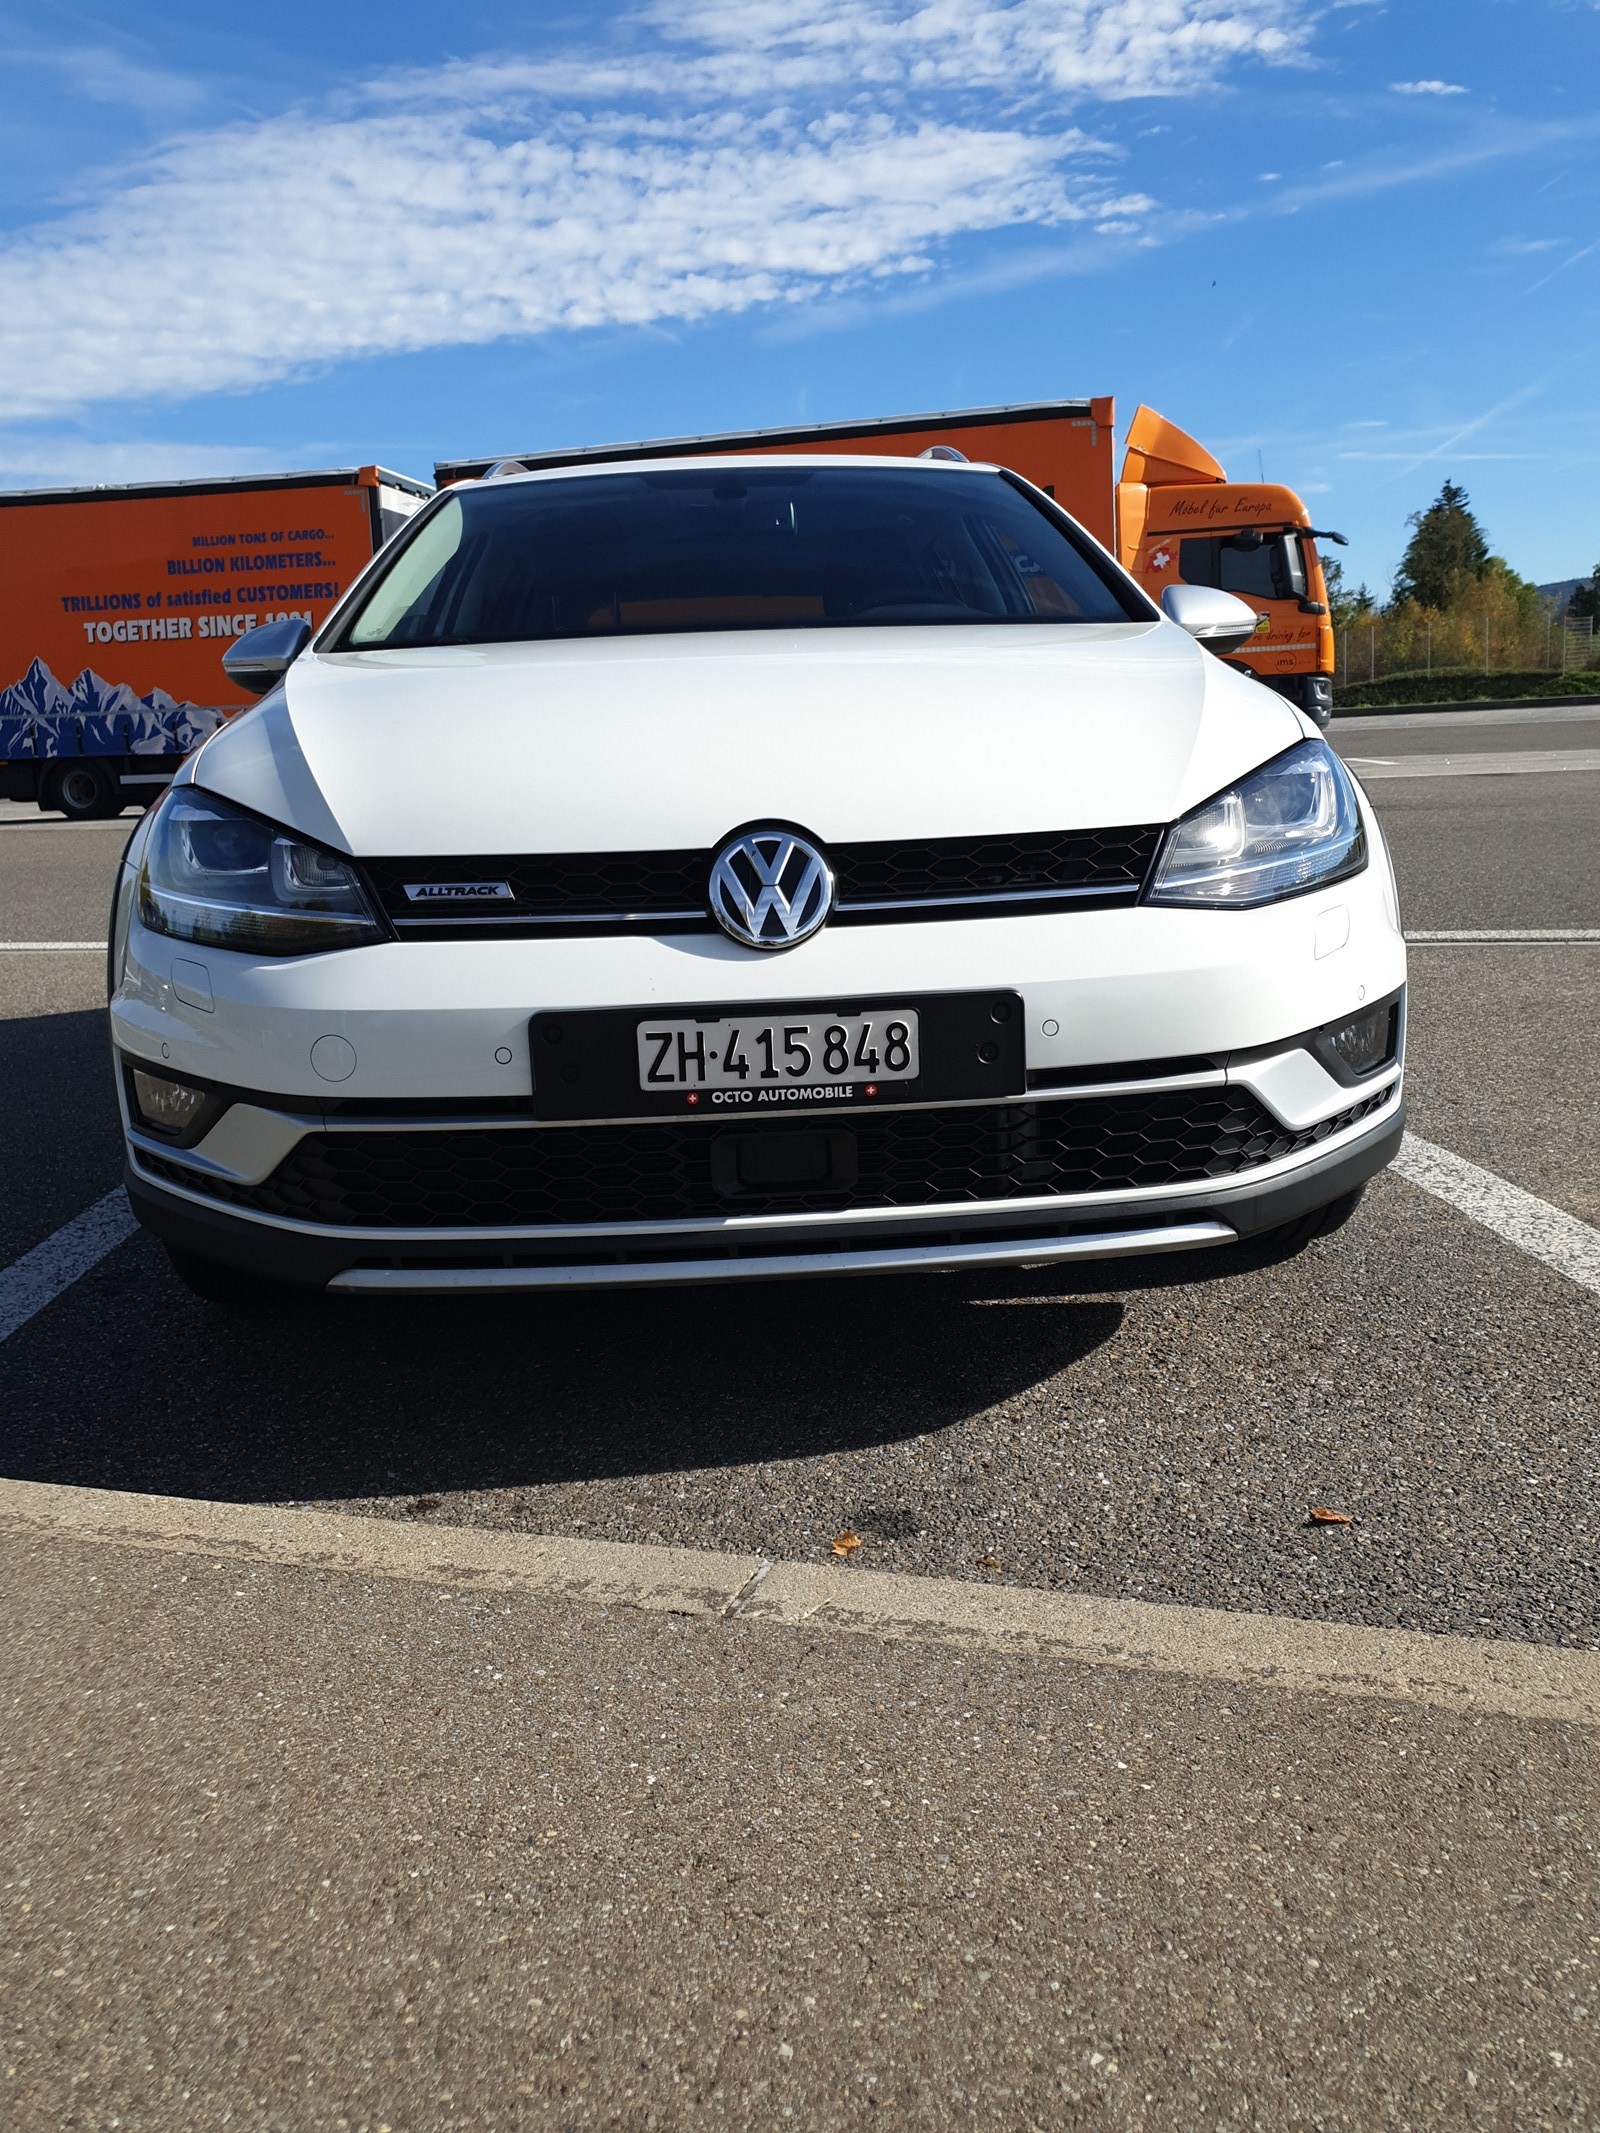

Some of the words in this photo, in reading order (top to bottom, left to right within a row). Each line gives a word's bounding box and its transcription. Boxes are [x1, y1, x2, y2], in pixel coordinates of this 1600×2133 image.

[1233, 497, 1272, 517] Europa
[192, 534, 236, 547] MILLION
[239, 532, 267, 545] TONS
[270, 531, 284, 542] OF
[167, 557, 225, 576] BILLION
[230, 551, 336, 572] KILOMETERS...
[61, 593, 141, 613] TRILLIONS
[146, 591, 162, 608] of
[166, 588, 232, 607] satisfied
[236, 582, 340, 604] CUSTOMERS!
[83, 617, 193, 644] TOGETHER
[198, 613, 258, 638] SINCE
[415, 885, 500, 897] ALLTRACK
[711, 1089, 753, 1103] OCTO
[757, 1086, 853, 1102] AUTOMOBILE
